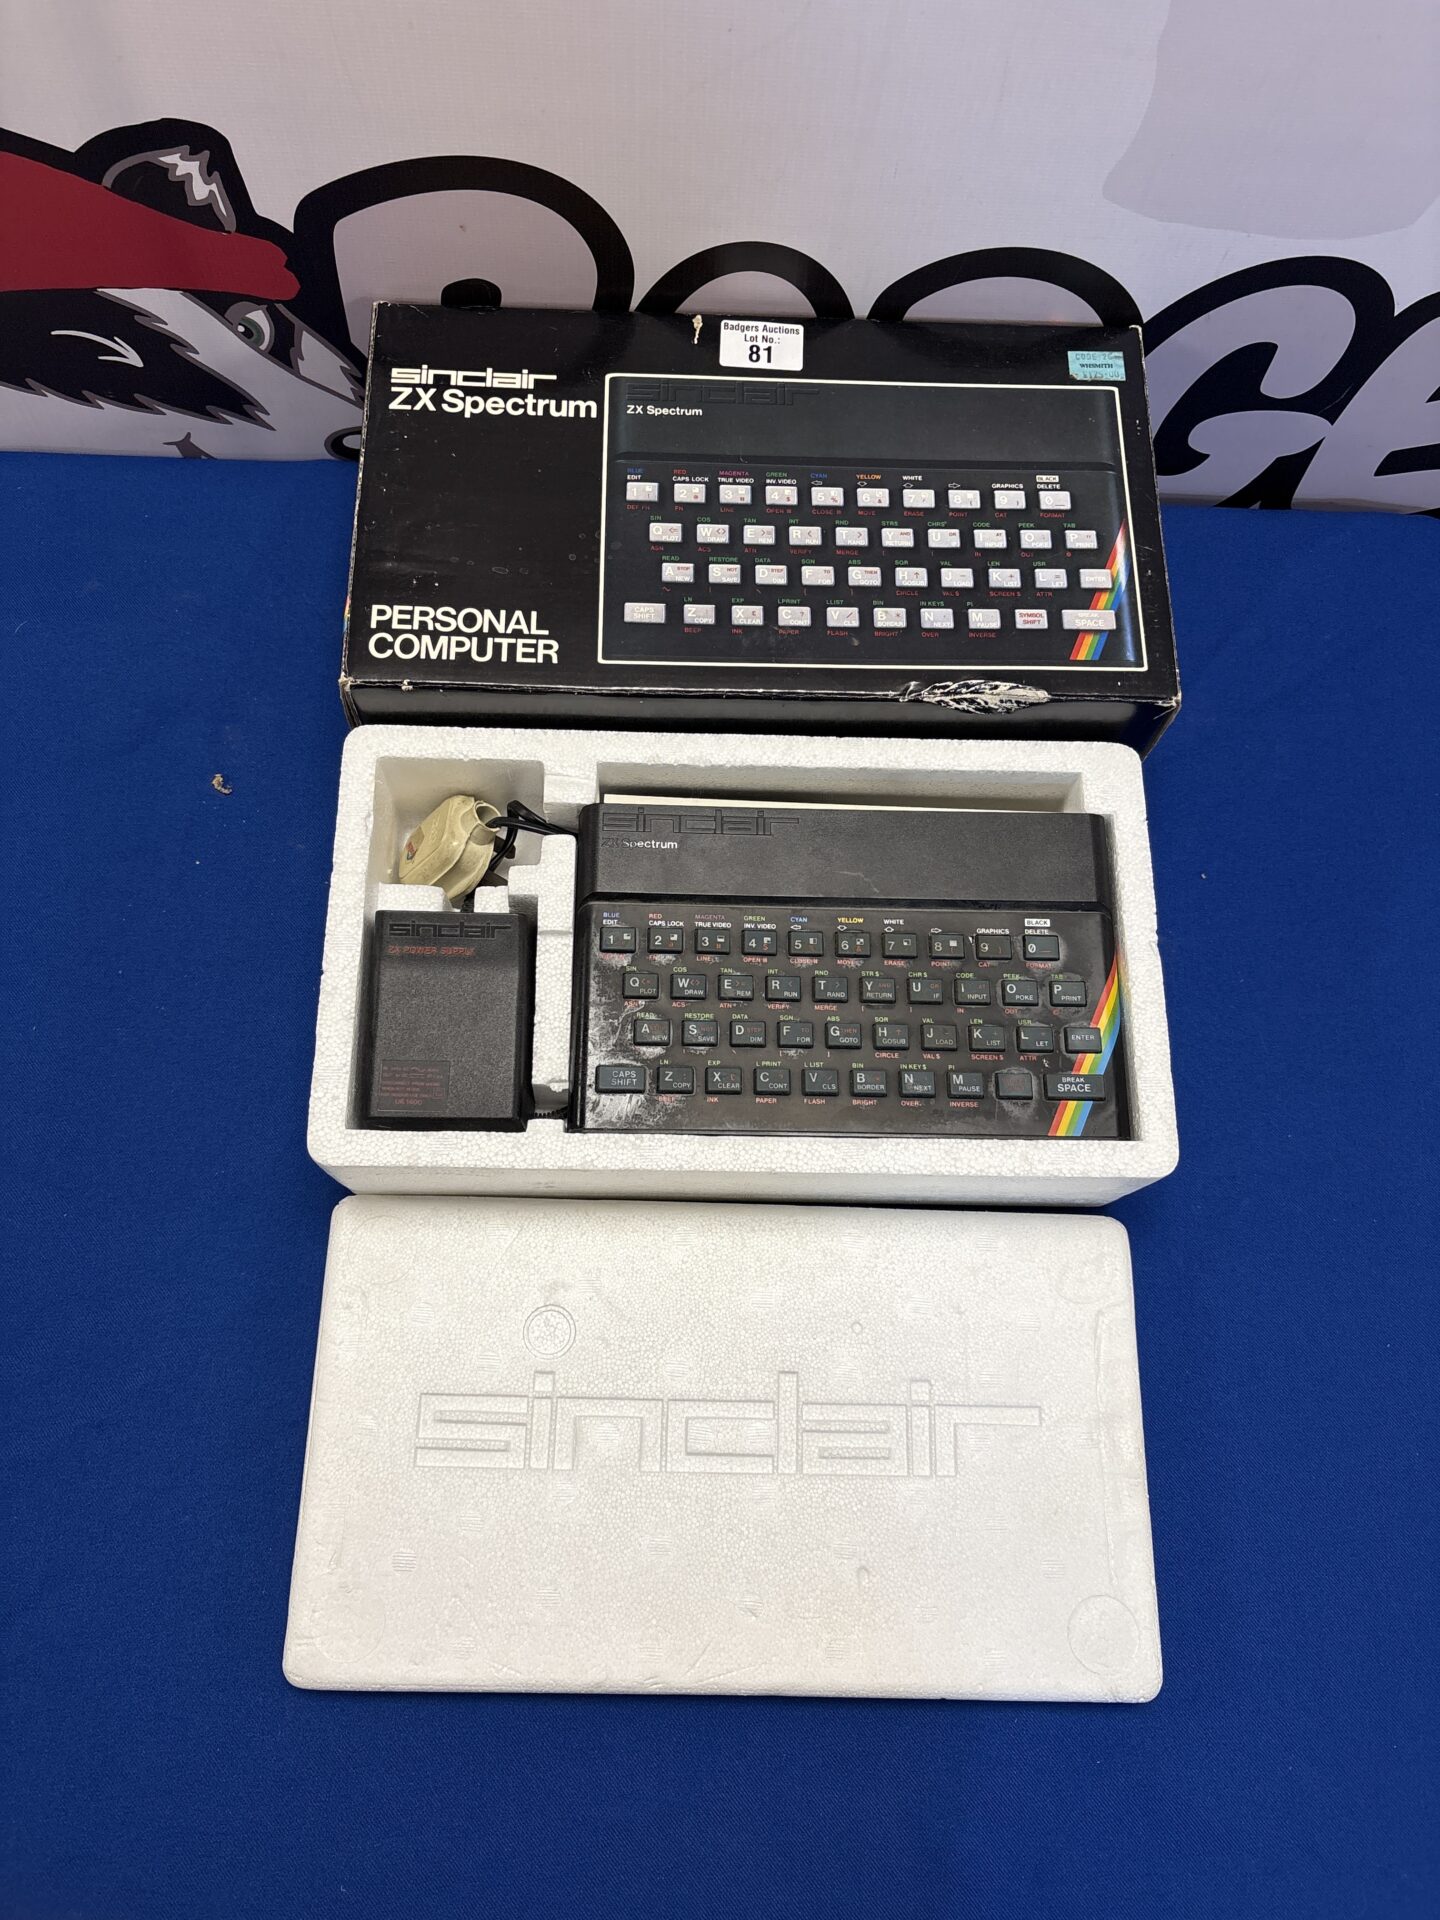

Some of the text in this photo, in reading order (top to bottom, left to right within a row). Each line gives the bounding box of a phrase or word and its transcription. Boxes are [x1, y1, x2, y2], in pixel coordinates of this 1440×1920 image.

[723, 322, 800, 336] Badgers Auctions
[744, 333, 780, 345] Lot No.:
[748, 344, 773, 364] 81
[390, 364, 557, 390] sinclair
[388, 386, 598, 418] ZX Spectrum
[626, 404, 703, 417] ZX Spectrum
[672, 475, 710, 484] CAPS LOCK
[370, 604, 549, 635] PERSONAL
[633, 612, 656, 620] SHIFT
[1075, 619, 1105, 627] SPACE
[368, 632, 559, 664] COMPUTER
[602, 807, 800, 836] sinclair
[601, 838, 678, 850] ZX Spectrum
[388, 919, 512, 939] sinclair
[667, 920, 685, 928] LOCK
[677, 977, 690, 988] W
[612, 1070, 637, 1078] CAPS
[611, 1078, 638, 1086] SHIFT
[1057, 1084, 1092, 1092] SPACE
[414, 1370, 1042, 1478] sinclair
